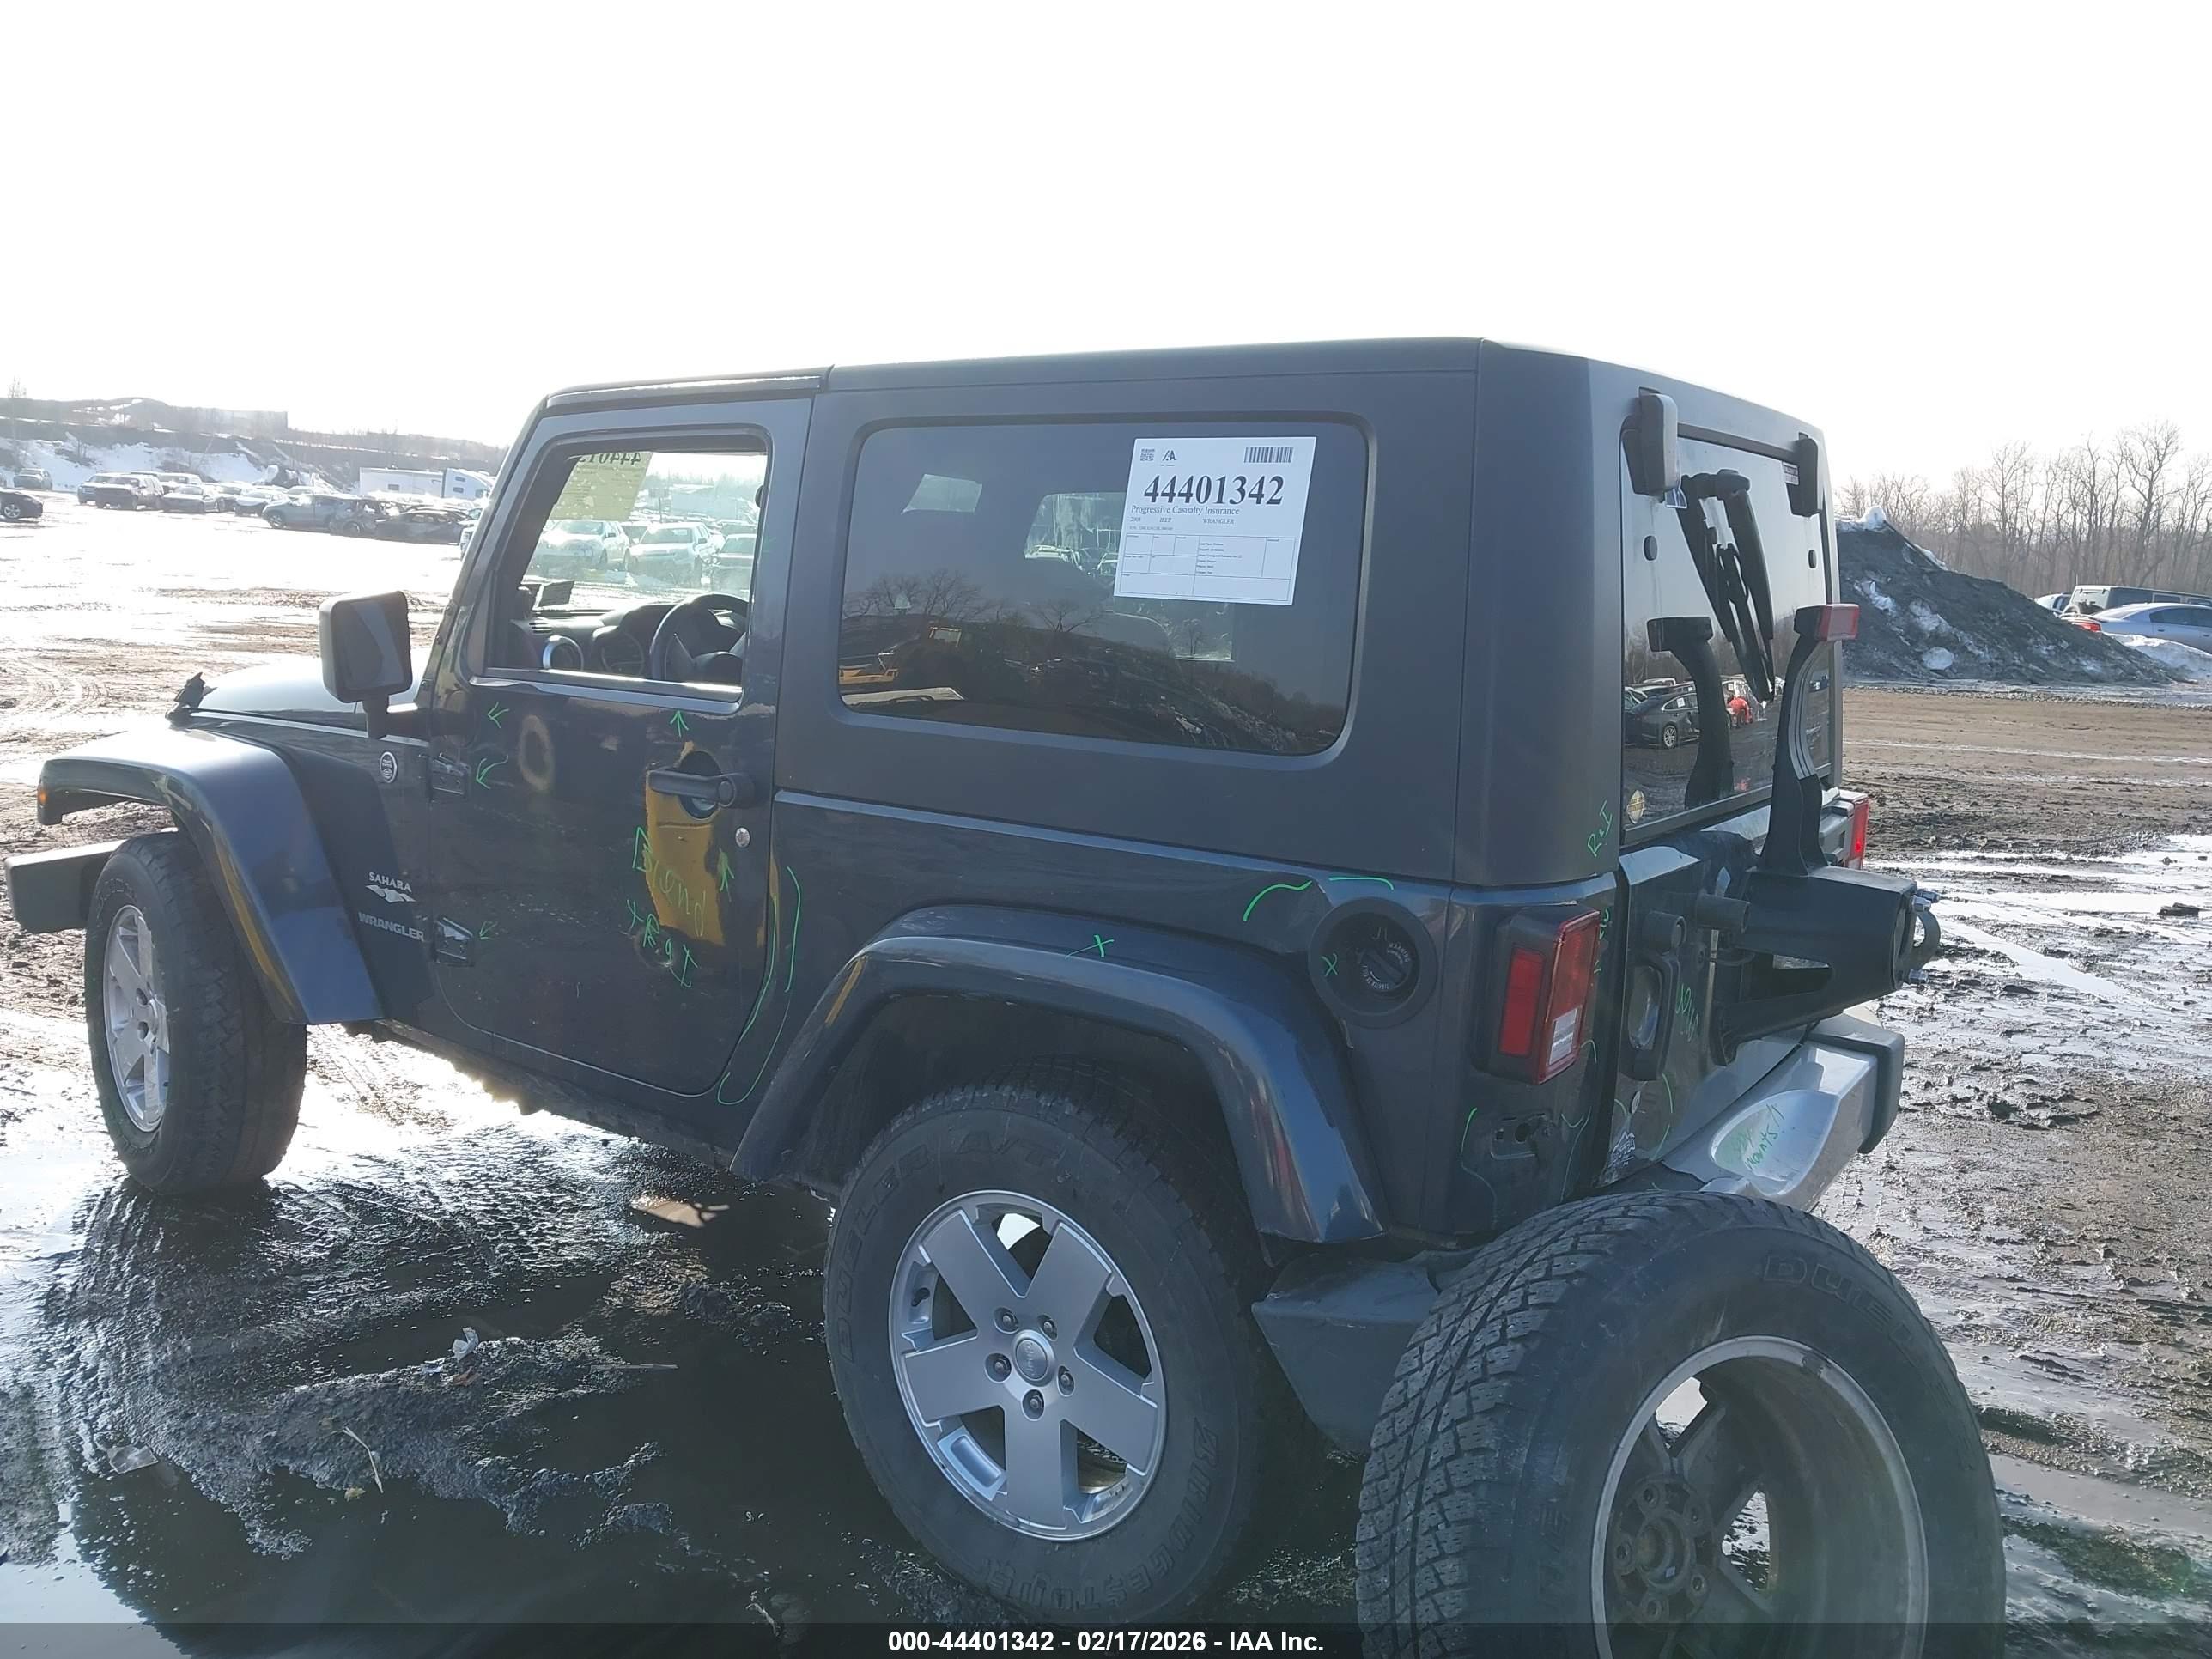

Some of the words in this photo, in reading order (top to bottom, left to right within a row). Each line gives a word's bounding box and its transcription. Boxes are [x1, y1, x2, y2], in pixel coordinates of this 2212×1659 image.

[1144, 475, 1285, 505] 44401342
[1131, 505, 1170, 515] Progressive
[1172, 506, 1203, 515] Casualty
[1205, 506, 1239, 515] Insurance
[368, 872, 412, 893] SAHARA
[358, 911, 424, 942] WRANGLER
